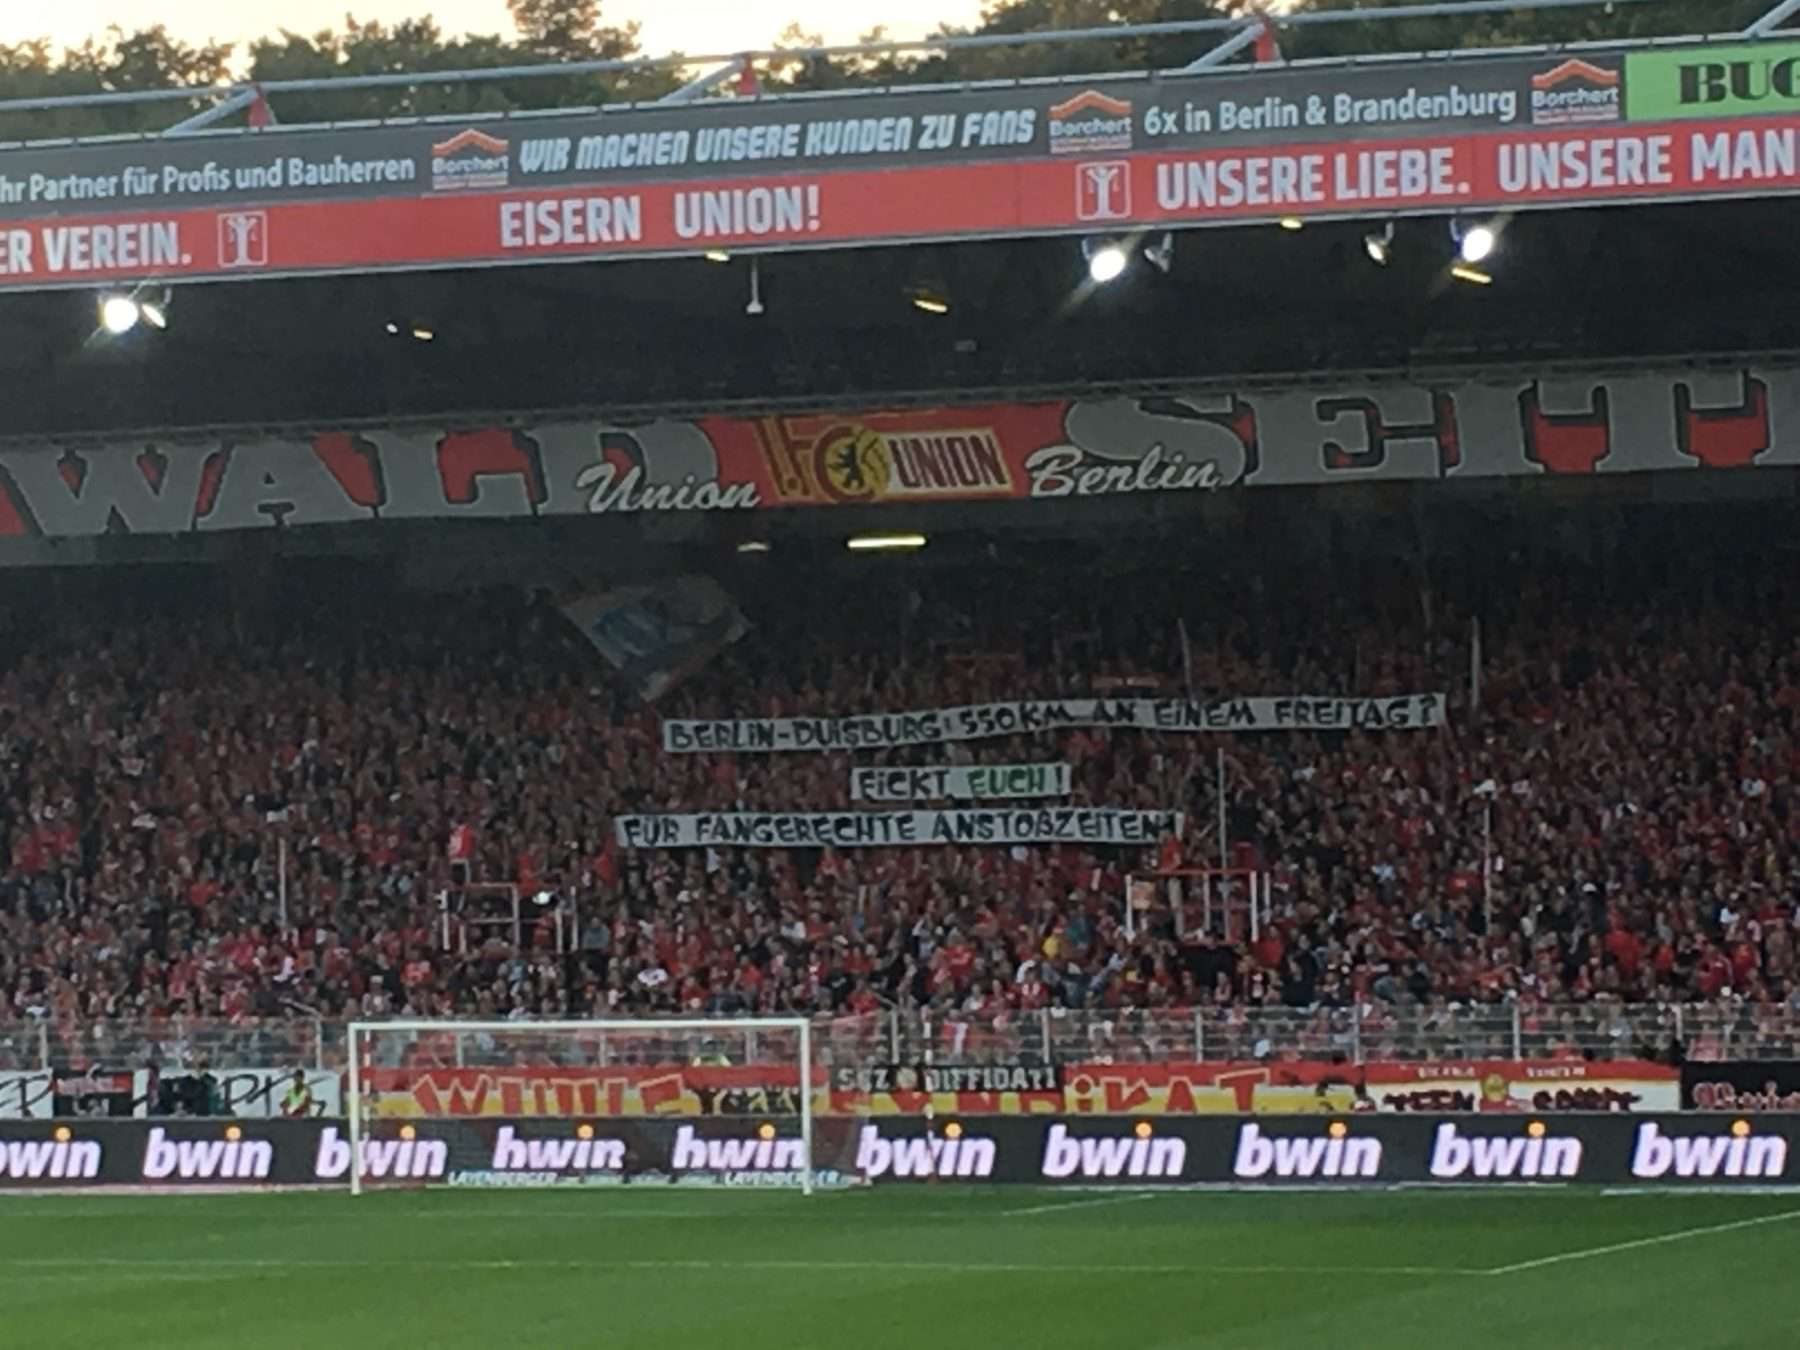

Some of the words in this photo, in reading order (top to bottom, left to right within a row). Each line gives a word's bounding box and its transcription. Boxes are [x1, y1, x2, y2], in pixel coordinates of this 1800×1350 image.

[1144, 106, 1179, 136] 6x
[1184, 101, 1211, 133] in
[1219, 97, 1298, 132] Berlin
[1305, 95, 1327, 125] &
[1333, 86, 1517, 124] Brandenburg
[1531, 86, 1618, 108] Borchert
[520, 139, 569, 173] WIR
[576, 130, 687, 169] MACHEN
[698, 123, 800, 163] UNSERE
[805, 116, 910, 157] KUNDEN
[918, 114, 956, 151] ZU
[961, 108, 1037, 149] FANS
[1049, 117, 1132, 136] Borchert
[30, 172, 119, 201] Partner
[123, 165, 159, 197] für
[163, 161, 231, 194] Profis
[235, 157, 283, 189] und
[288, 154, 416, 186] Bauherren
[432, 155, 509, 175] Borchert
[1156, 154, 1325, 211] UNSERE
[1334, 146, 1471, 200] LIEBE.
[1500, 136, 1673, 193] UNSERE
[1691, 128, 1795, 182] MAN
[501, 194, 641, 248] EISERN
[674, 184, 821, 240] UNION!
[42, 220, 193, 272] VEREIN.
[576, 462, 762, 512] Union
[888, 434, 1008, 488] UNION
[1026, 445, 1221, 498] Berlin
[1093, 699, 1136, 723] AN
[623, 814, 679, 846] FÜR
[696, 812, 916, 844] FANGERECHTE
[142, 1125, 273, 1178] bwin
[315, 1124, 448, 1178] bwin
[856, 1121, 996, 1177] bwin
[1042, 1121, 1187, 1177] bwin
[1234, 1120, 1382, 1176] bwin
[1430, 1119, 1583, 1176] bwin
[1632, 1119, 1788, 1176] bwin
